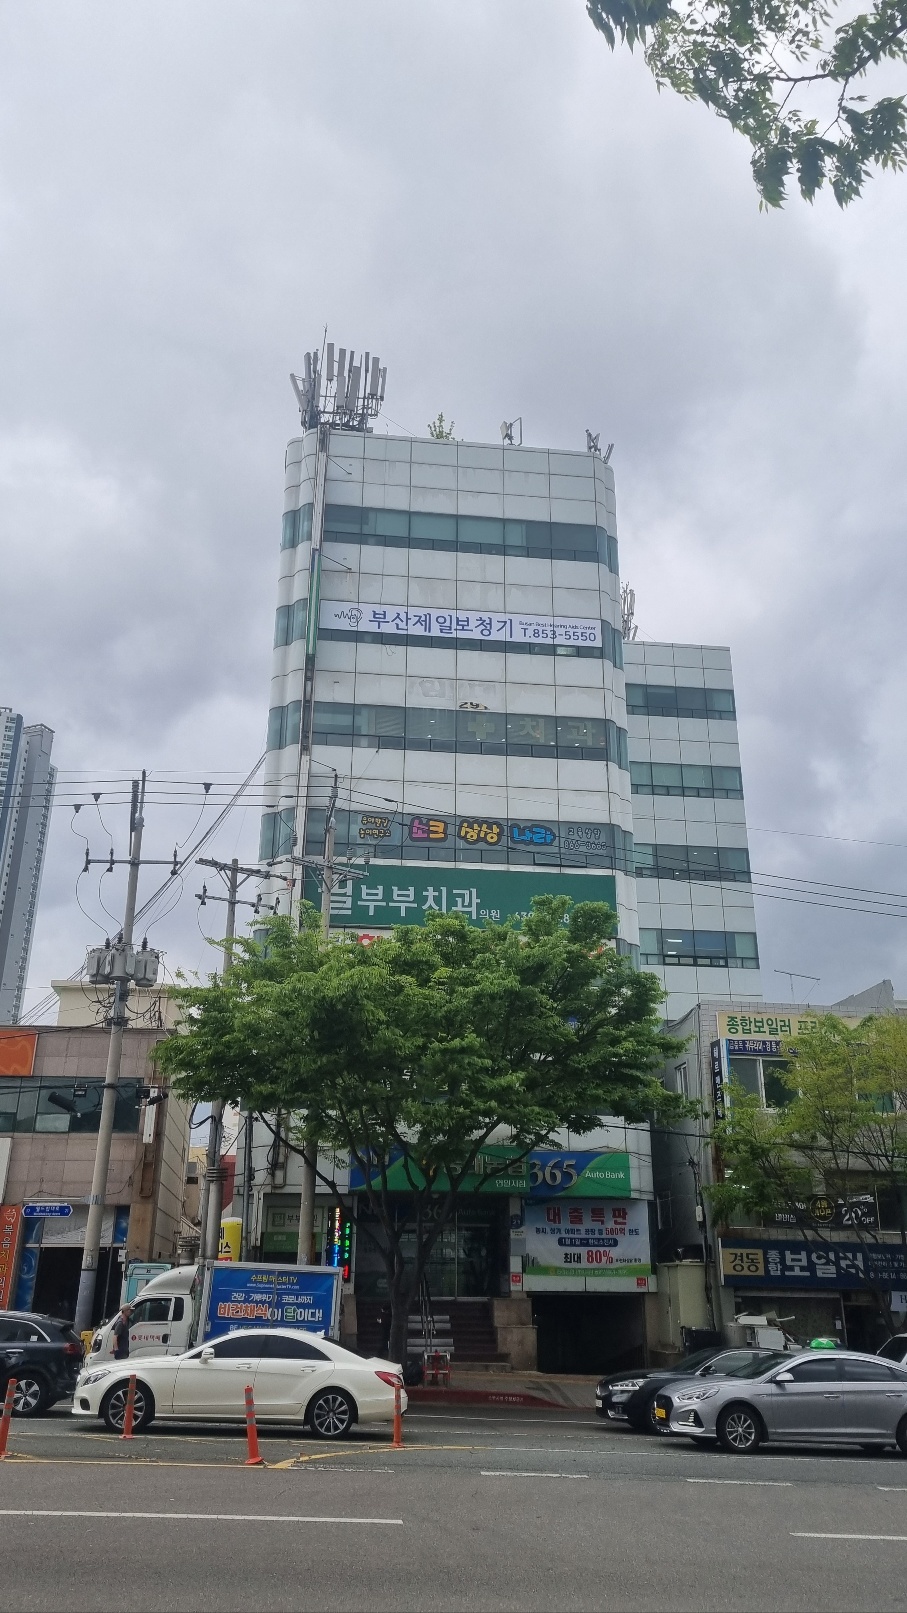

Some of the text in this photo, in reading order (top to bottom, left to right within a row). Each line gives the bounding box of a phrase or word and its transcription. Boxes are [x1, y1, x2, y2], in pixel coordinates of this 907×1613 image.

[368, 610, 513, 639] 부산제일보청기
[520, 627, 597, 642] T.853-5550
[358, 828, 392, 839] 놀이연구소
[460, 822, 500, 842] 상상
[513, 827, 554, 843] 나라
[479, 909, 501, 921] 의원
[726, 1015, 792, 1037] 종합보일러
[529, 1158, 626, 1188] 365 Auto Bank
[545, 1206, 629, 1226] 대출특판
[605, 1227, 626, 1236] 500억
[628, 1227, 640, 1236] 한도
[563, 1252, 582, 1264] 최대
[586, 1249, 613, 1265] 80%
[729, 1252, 761, 1273] 경동
[766, 1249, 783, 1276] 종합
[784, 1250, 865, 1279] 보일러
[289, 1276, 298, 1284] TV
[231, 1292, 245, 1301] 건강
[284, 1305, 323, 1322] 답이다!
